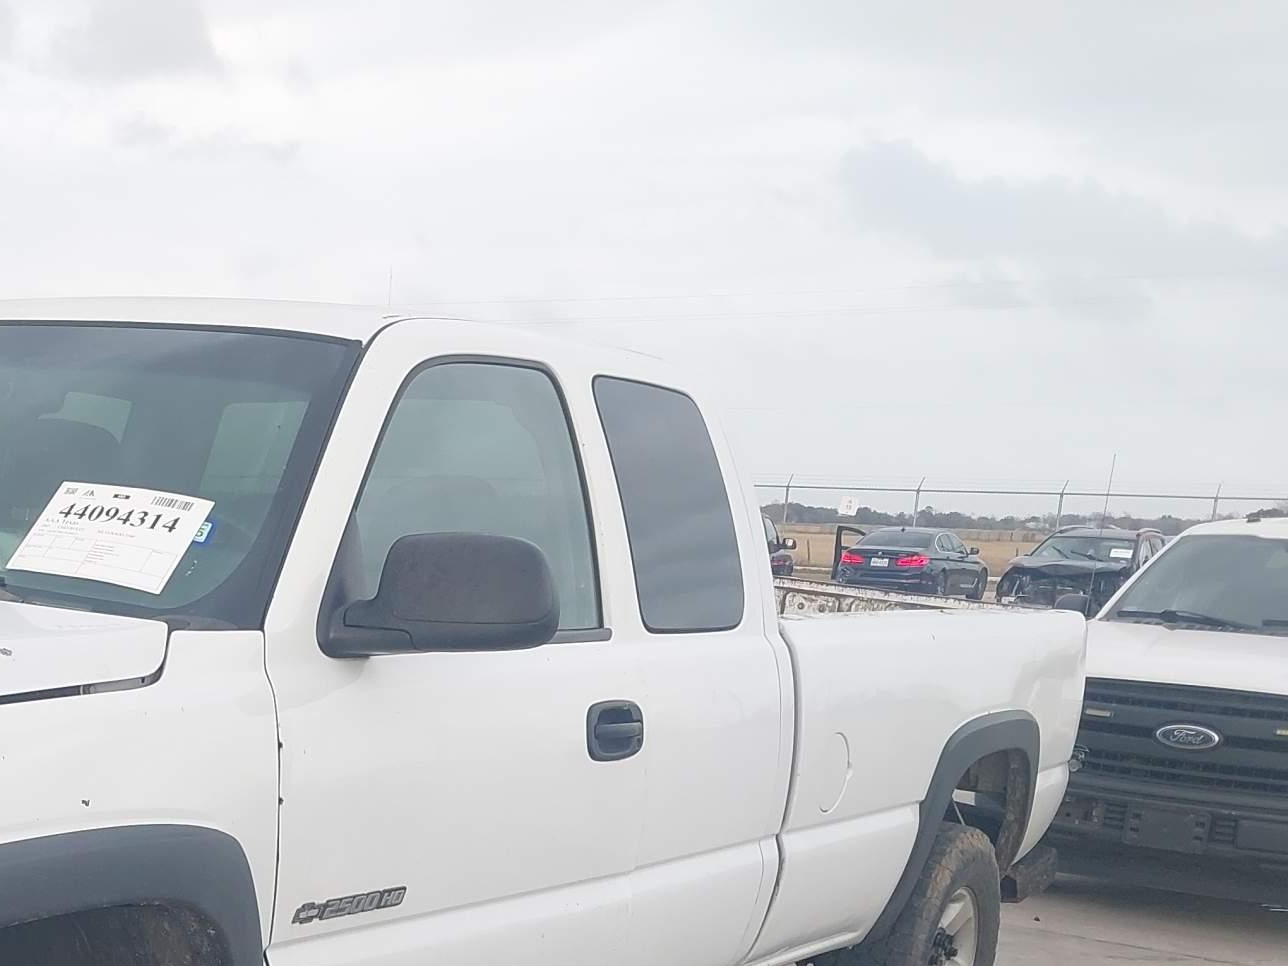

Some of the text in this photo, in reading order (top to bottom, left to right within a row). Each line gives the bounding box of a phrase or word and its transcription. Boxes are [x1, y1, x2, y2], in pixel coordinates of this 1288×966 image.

[58, 503, 181, 533] 44094314
[1169, 729, 1205, 745] Ford
[320, 888, 406, 920] 2500 HD
